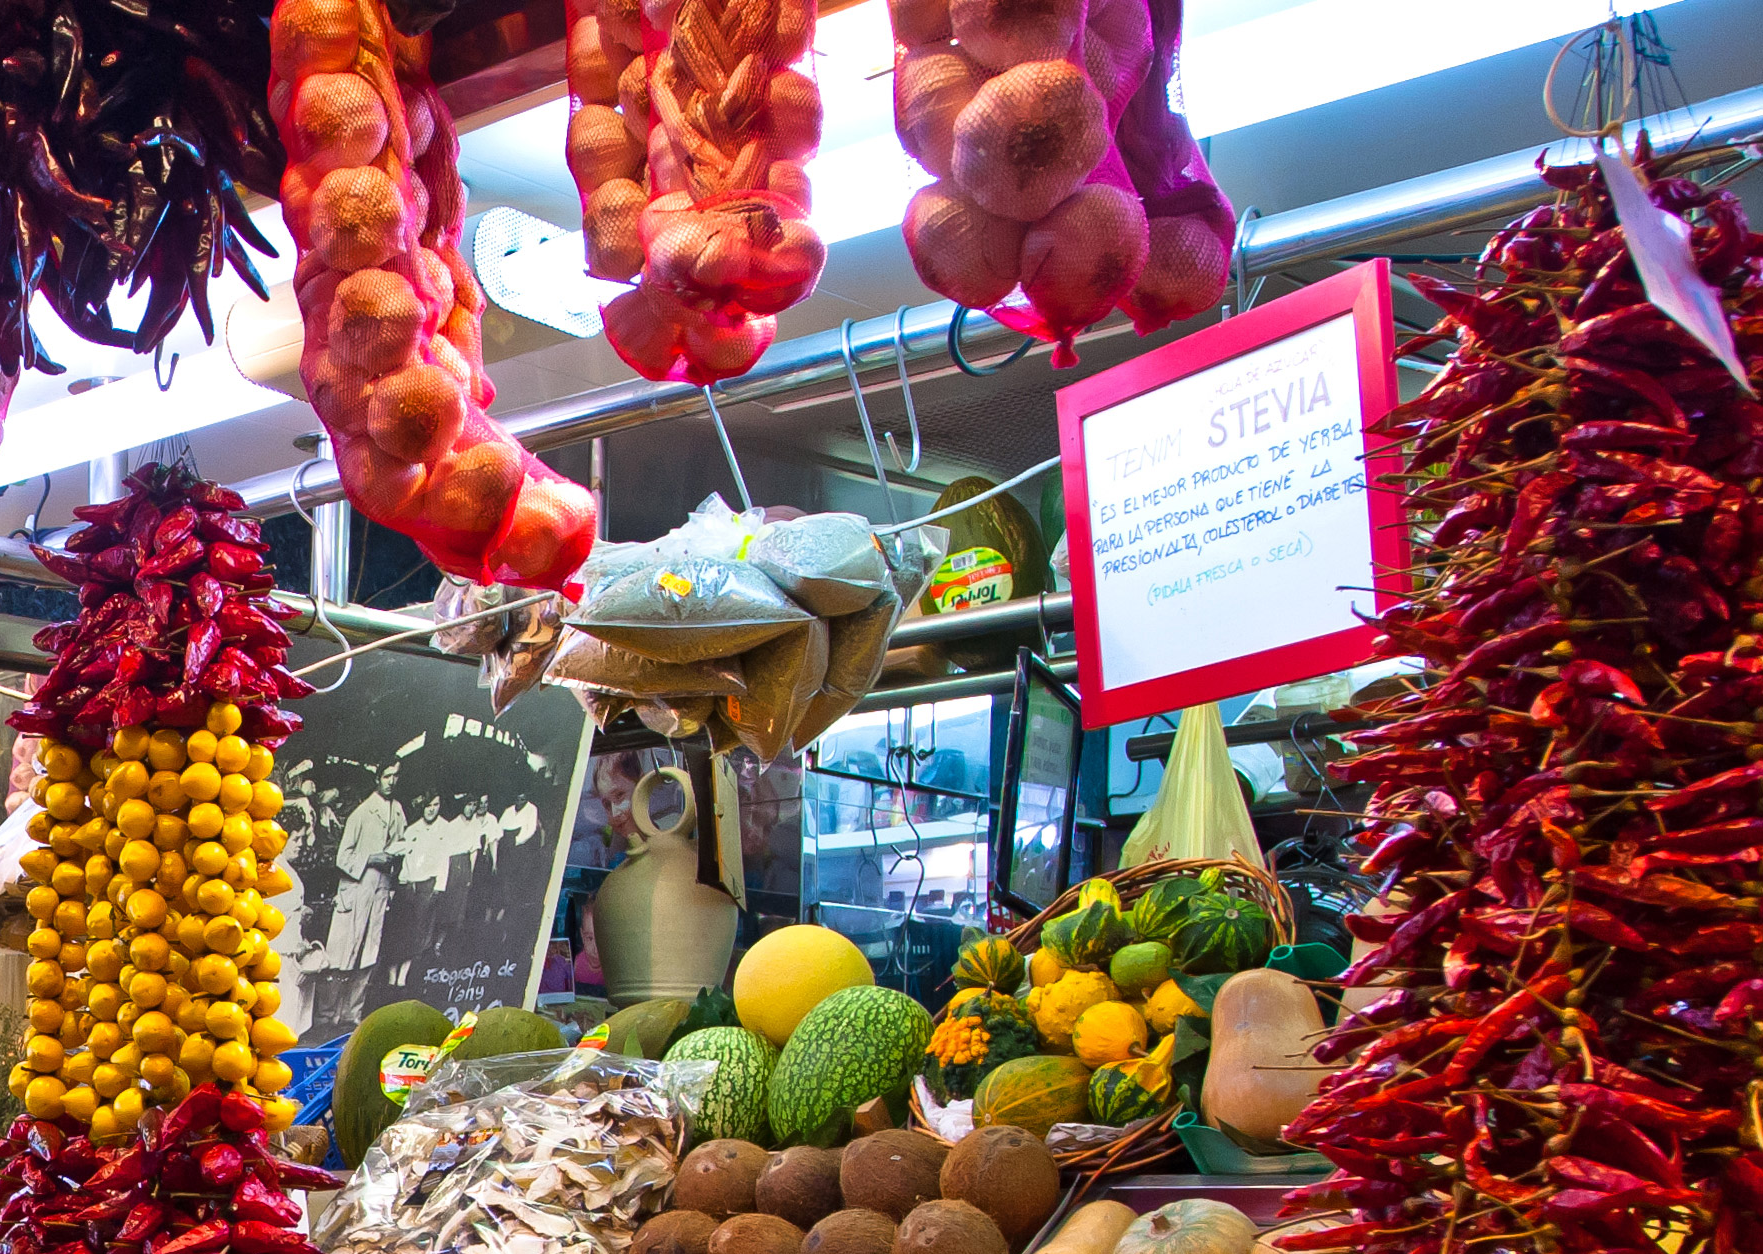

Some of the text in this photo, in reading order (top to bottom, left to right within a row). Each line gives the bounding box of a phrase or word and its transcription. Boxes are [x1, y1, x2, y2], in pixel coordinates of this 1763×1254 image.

[1106, 371, 1332, 482] TENIM STEVIA
[1142, 477, 1187, 508] MEJOR
[1192, 454, 1260, 490] PRODUCTO
[1268, 441, 1290, 463] DE
[1298, 418, 1354, 453] YERBA
[1093, 532, 1124, 556] PARA
[1128, 523, 1144, 543] LA
[1144, 502, 1210, 537] PERSONA
[1215, 490, 1243, 512] QUE
[1310, 459, 1333, 479] LA
[1203, 507, 1284, 545] COLESTEROL
[1296, 472, 1366, 510] DIABETES
[1195, 561, 1245, 586] FRESCA
[423, 959, 518, 988] Fotografia de
